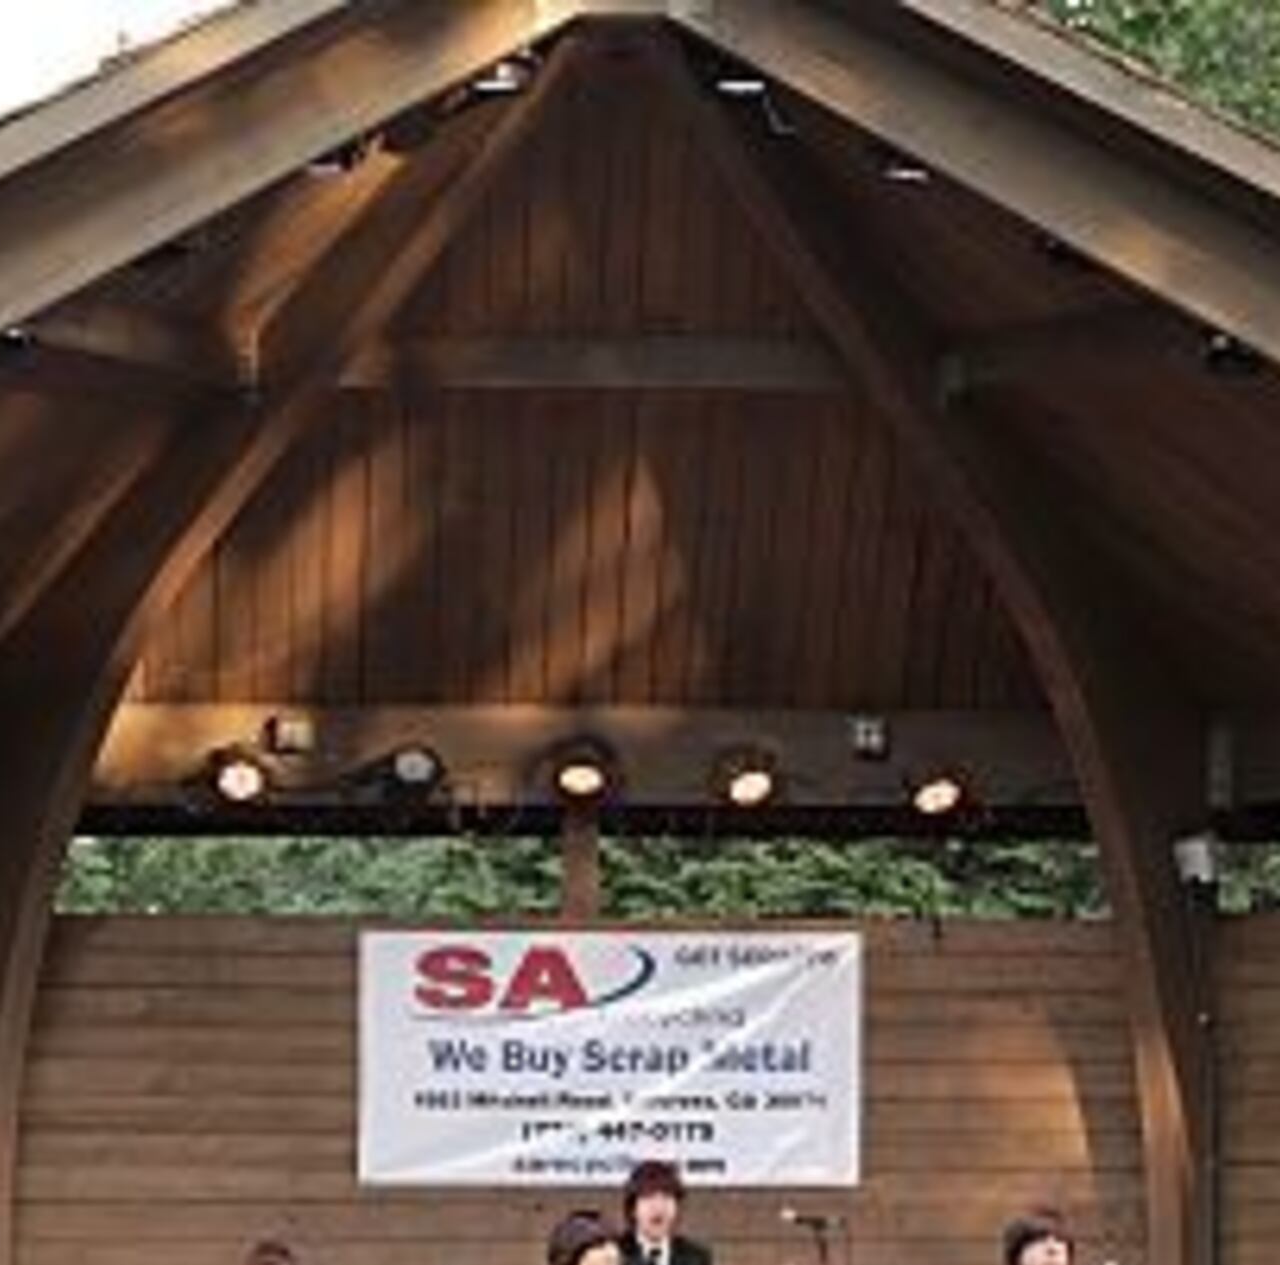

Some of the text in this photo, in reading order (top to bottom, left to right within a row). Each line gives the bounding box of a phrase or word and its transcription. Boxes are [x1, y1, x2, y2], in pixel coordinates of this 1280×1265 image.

[413, 944, 589, 1011] SA
[428, 1039, 488, 1074] We
[503, 1039, 574, 1079] Buy
[584, 1039, 689, 1079] Scrap
